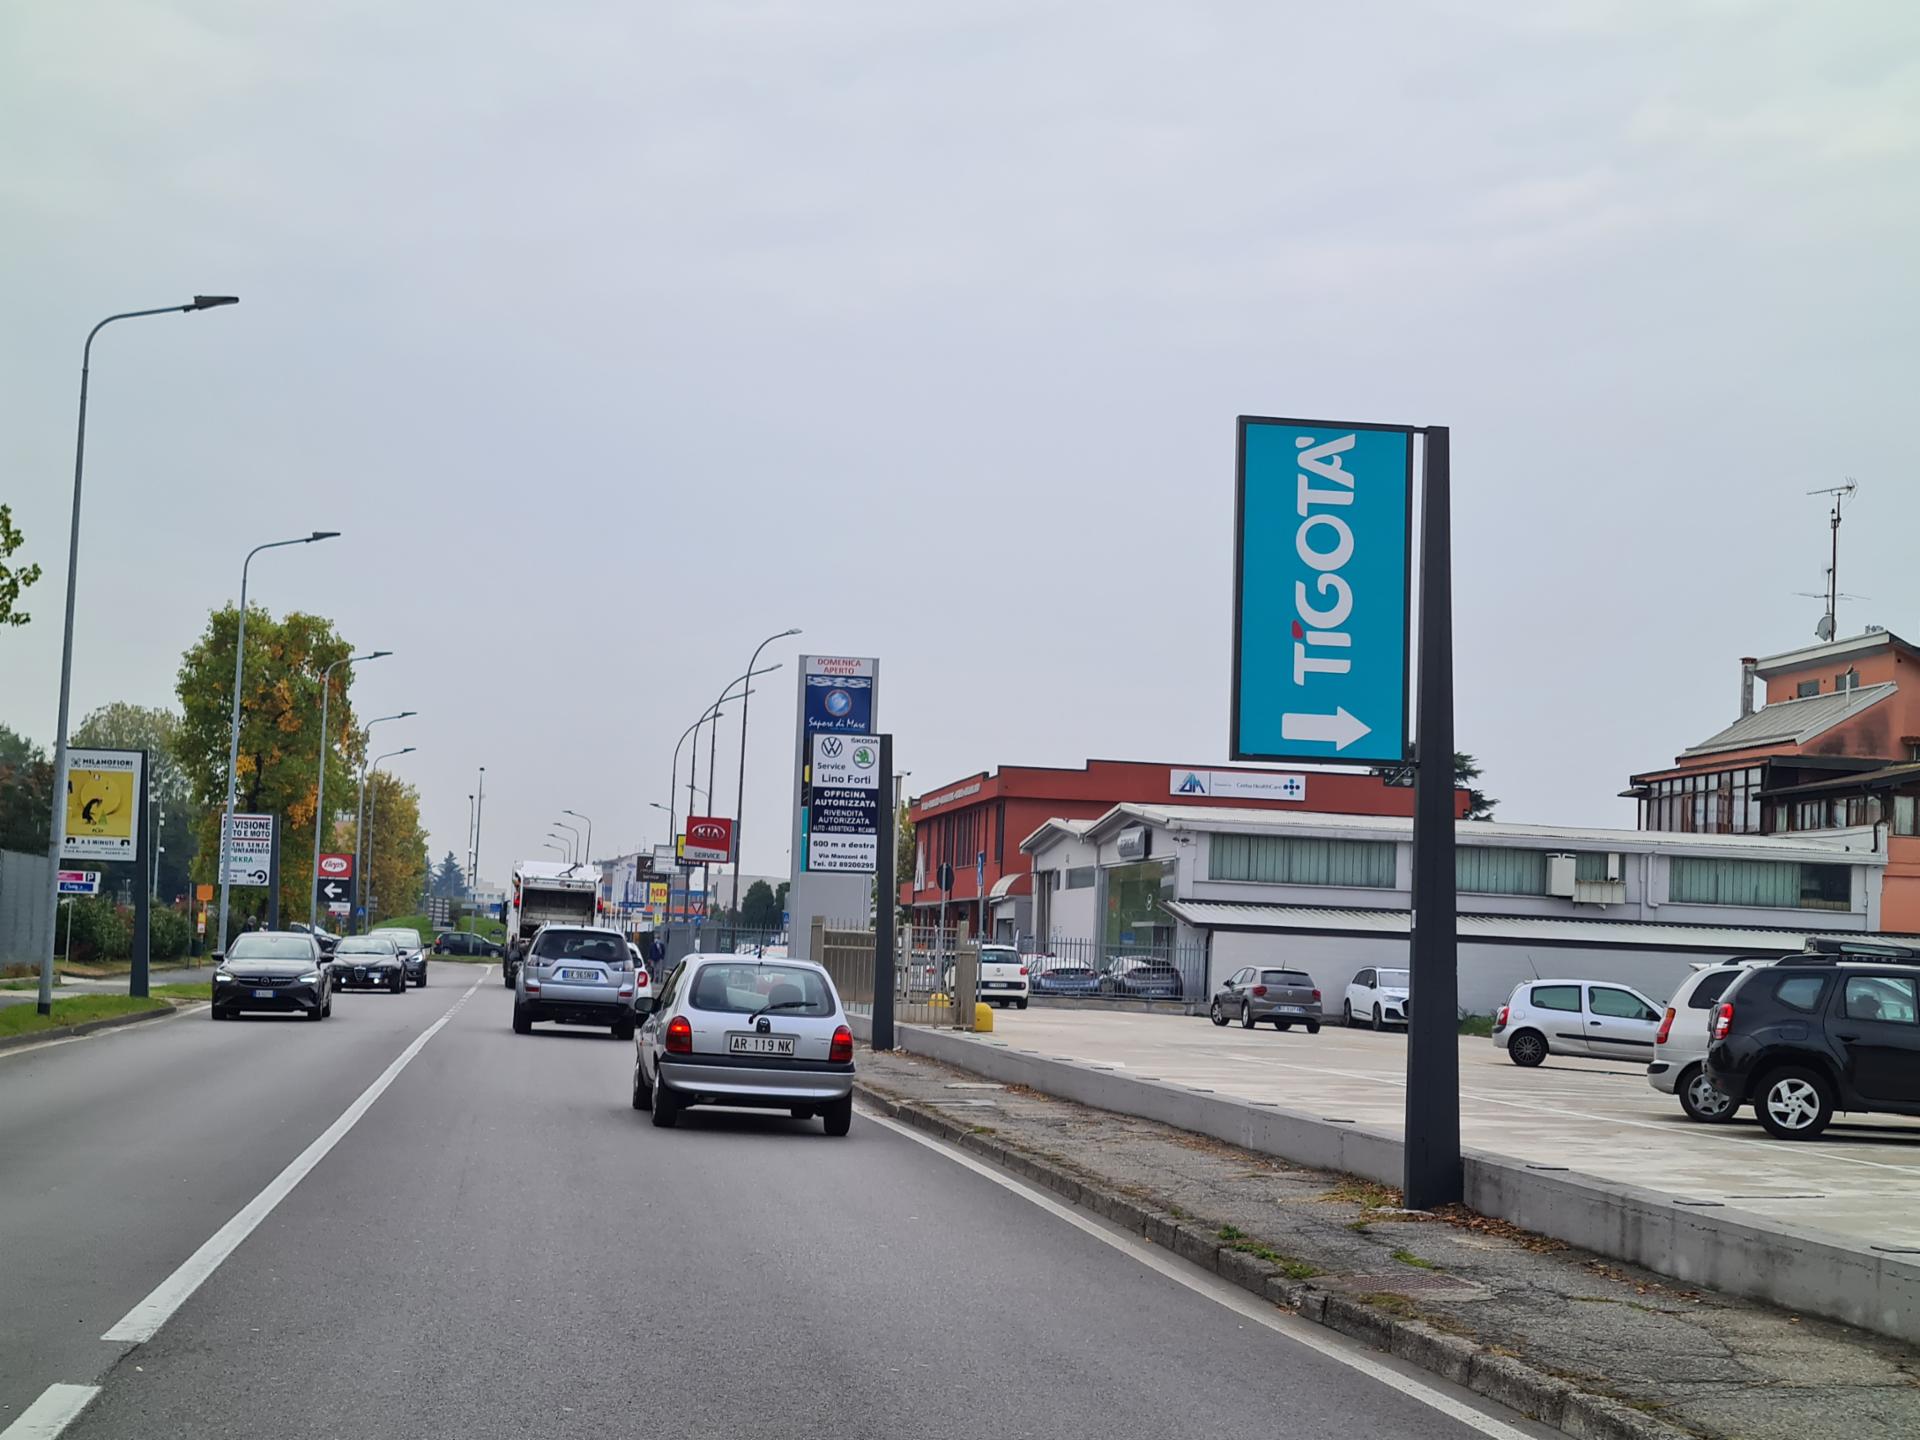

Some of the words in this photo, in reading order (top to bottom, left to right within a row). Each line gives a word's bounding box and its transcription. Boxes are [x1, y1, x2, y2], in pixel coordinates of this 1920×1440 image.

[817, 658, 861, 667] DOMENICA
[824, 667, 855, 675] APERTO
[808, 716, 834, 729] Sapore
[835, 718, 845, 727] di
[846, 718, 866, 729] Mare
[82, 758, 133, 767] MILANOFIORI
[817, 762, 846, 771] Service
[821, 774, 844, 784] Lino
[847, 774, 871, 785] Forti
[824, 790, 866, 799] OFFICINA
[814, 798, 876, 808] AUTORIZZATA
[823, 809, 864, 817] RIVENDITA
[818, 816, 870, 825] AUTORIZZATA
[250, 830, 270, 838] MOTO
[697, 828, 720, 839] KIA
[813, 840, 829, 848] 600
[848, 841, 875, 849] destra
[694, 851, 721, 859] SERVICE
[733, 1037, 747, 1050] AR
[755, 1039, 774, 1051] 119
[778, 1040, 792, 1052] NK
